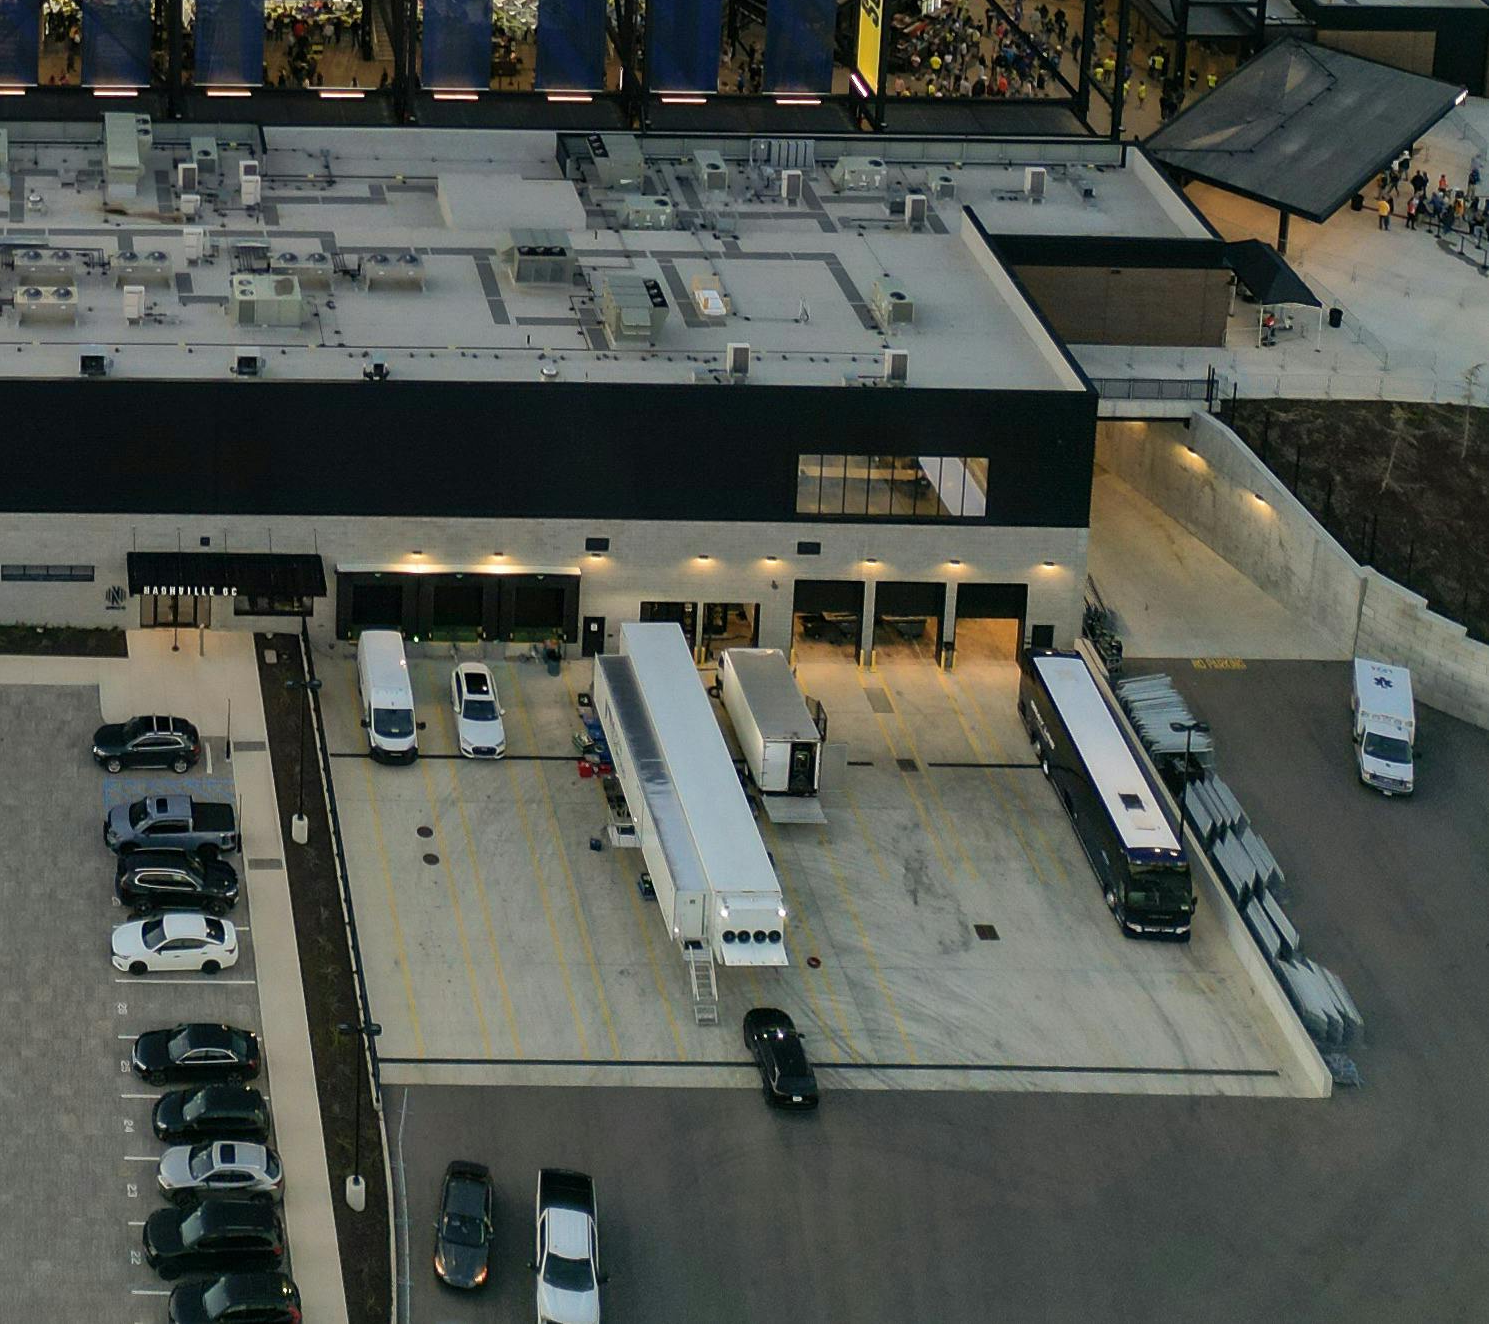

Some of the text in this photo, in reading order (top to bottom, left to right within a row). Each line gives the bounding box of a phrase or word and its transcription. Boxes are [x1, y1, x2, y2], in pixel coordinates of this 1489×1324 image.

[143, 585, 215, 597] NASHVILLE
[123, 1120, 135, 1133] 24
[126, 1185, 137, 1199] 23
[129, 1251, 140, 1266] 22
